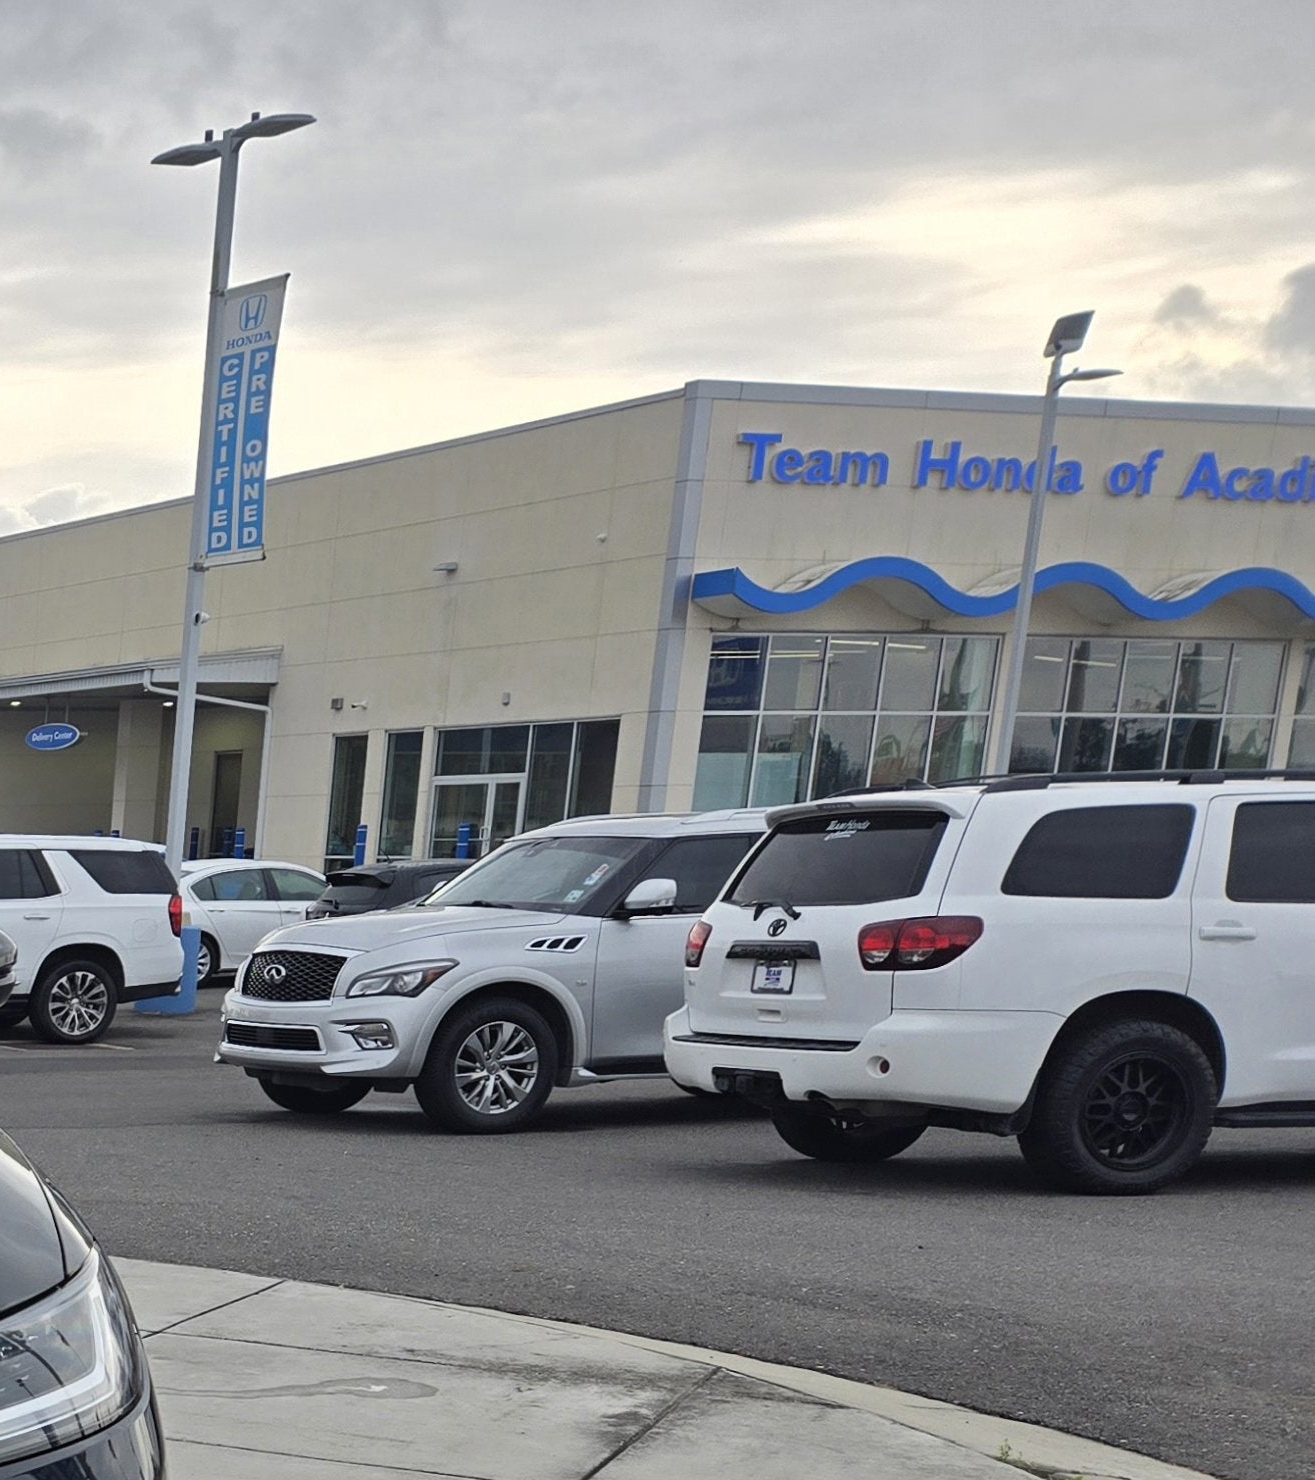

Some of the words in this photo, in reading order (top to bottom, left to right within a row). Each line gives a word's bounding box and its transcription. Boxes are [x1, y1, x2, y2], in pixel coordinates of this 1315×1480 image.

[226, 330, 273, 351] HONDA
[249, 351, 269, 414] PRE
[210, 357, 240, 550] CERTIFIED
[737, 432, 890, 486] Team
[1105, 449, 1165, 498] of
[242, 439, 263, 545] OWNED
